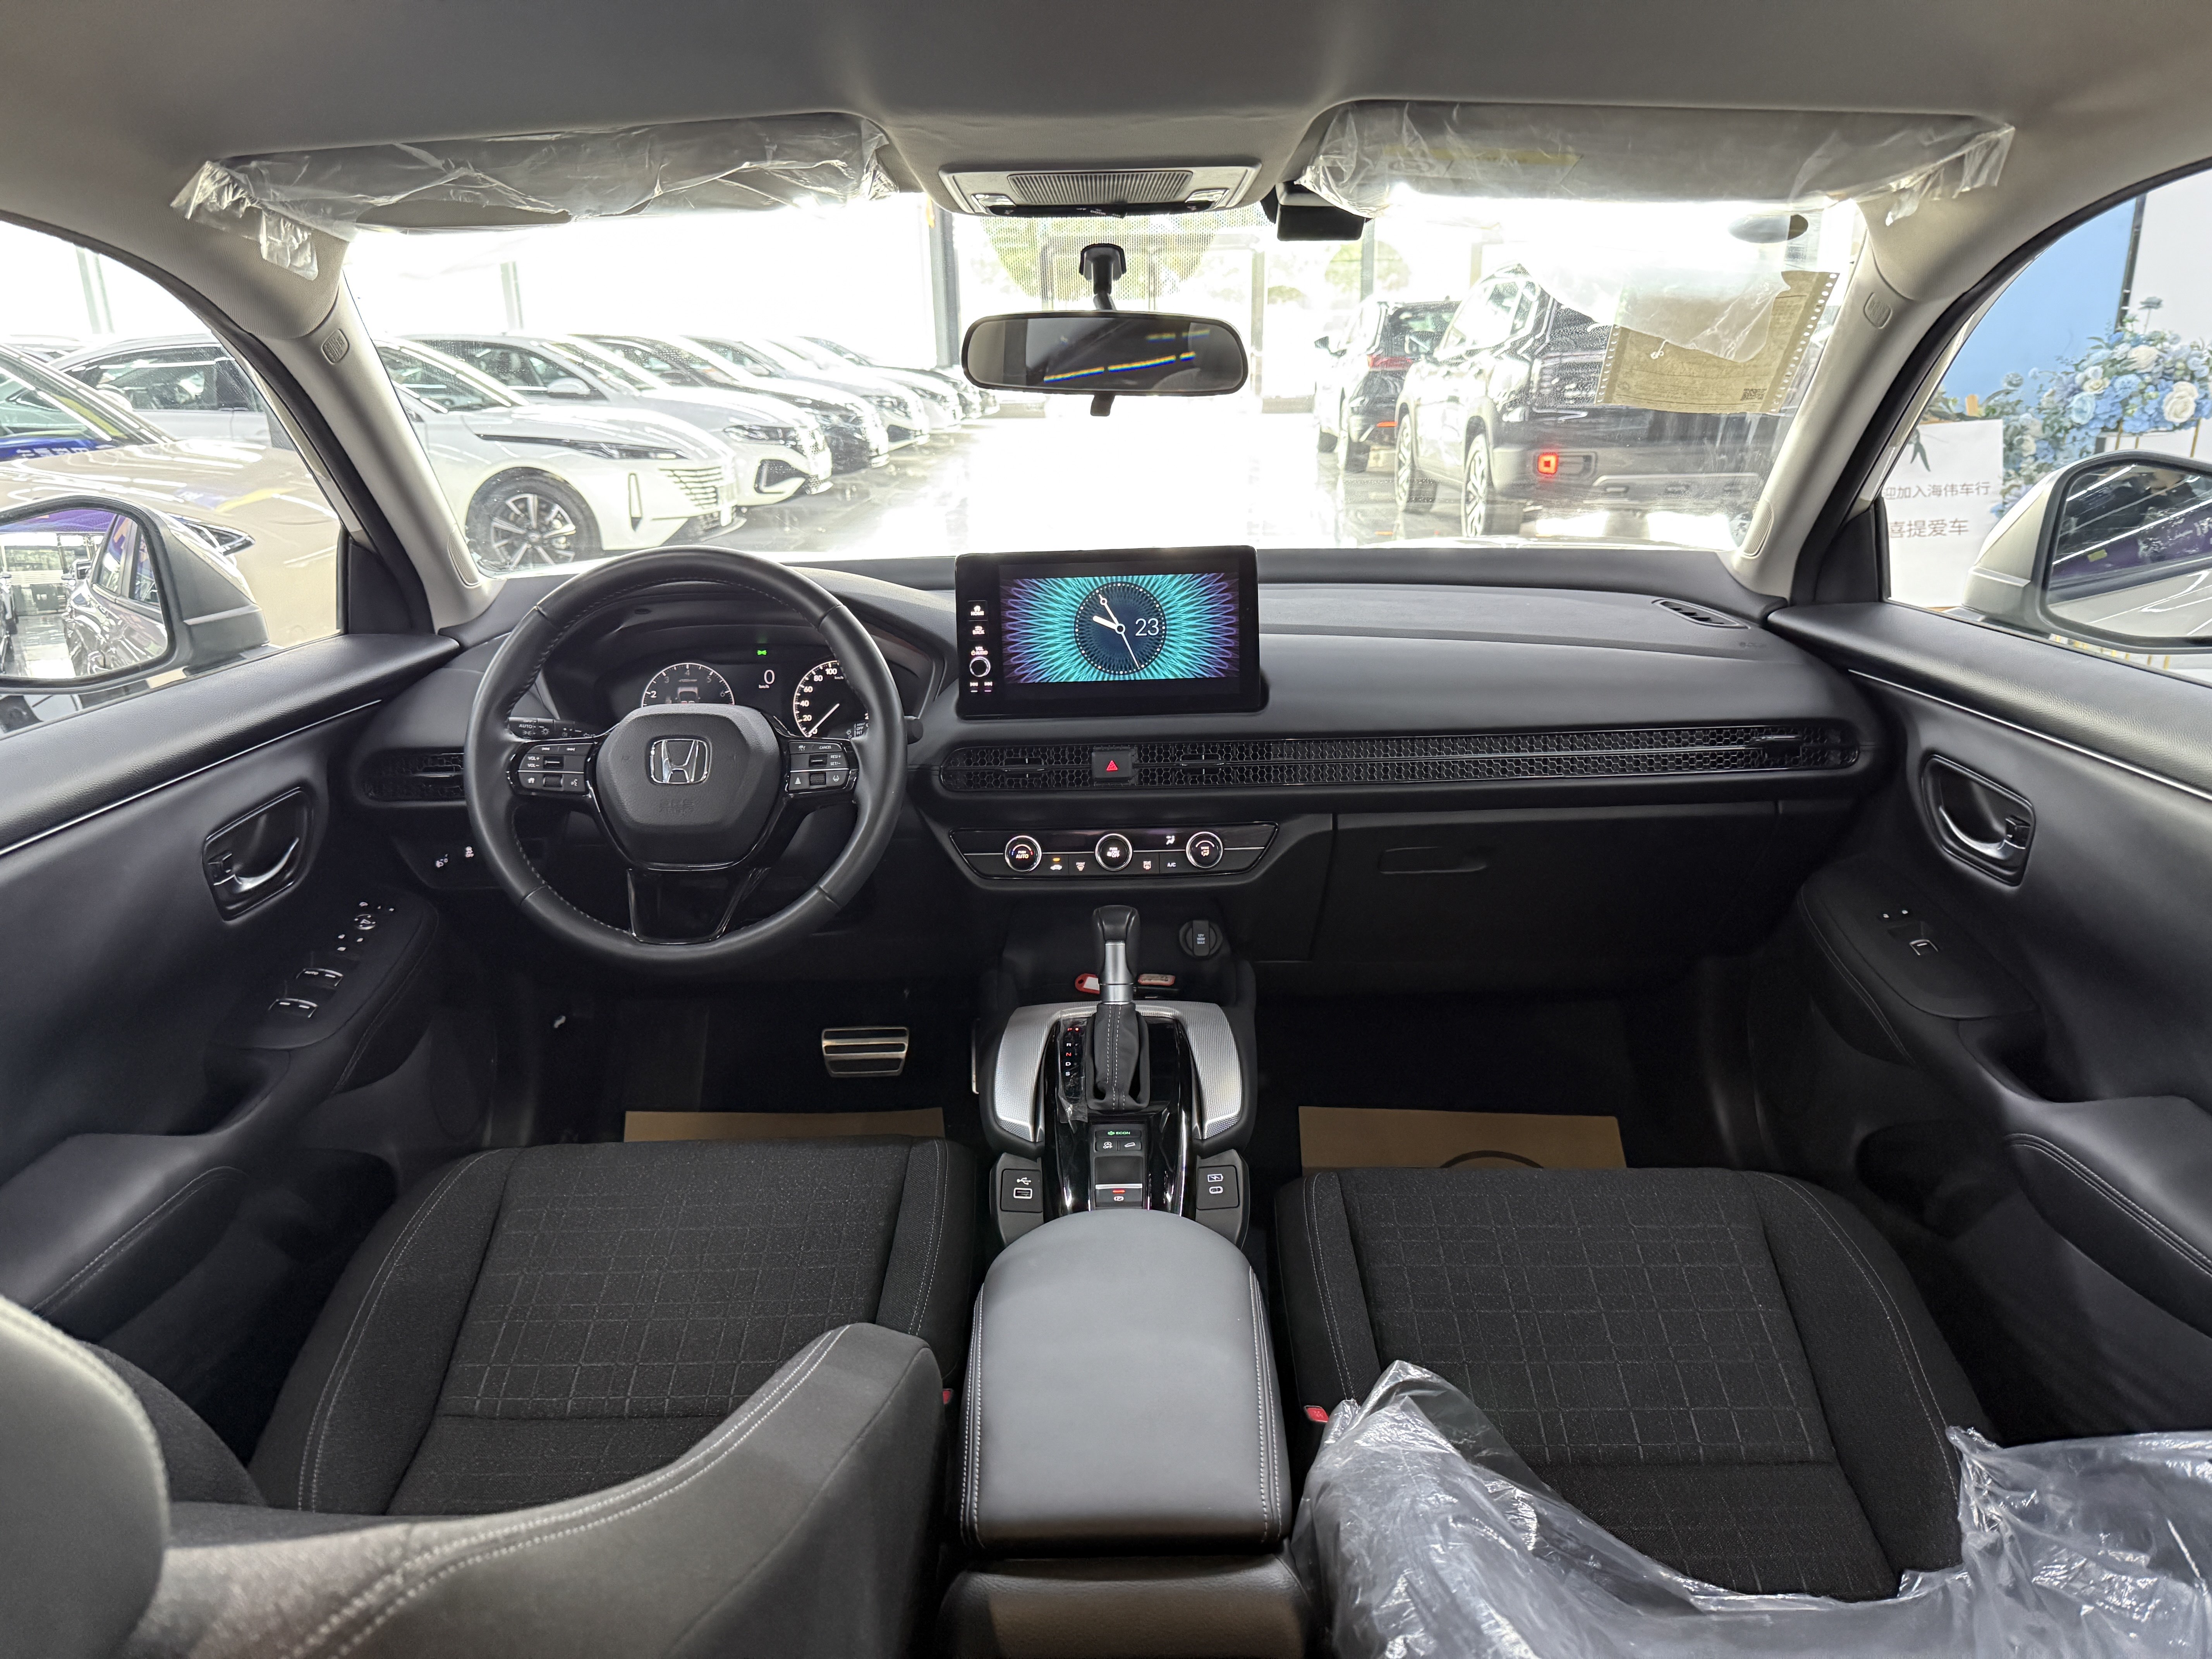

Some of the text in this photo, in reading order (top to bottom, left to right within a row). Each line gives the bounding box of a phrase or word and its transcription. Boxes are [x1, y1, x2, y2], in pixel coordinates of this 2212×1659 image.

[1889, 518, 1969, 538] 喜提爱车
[1135, 618, 1159, 636] 23
[764, 669, 775, 684] 0
